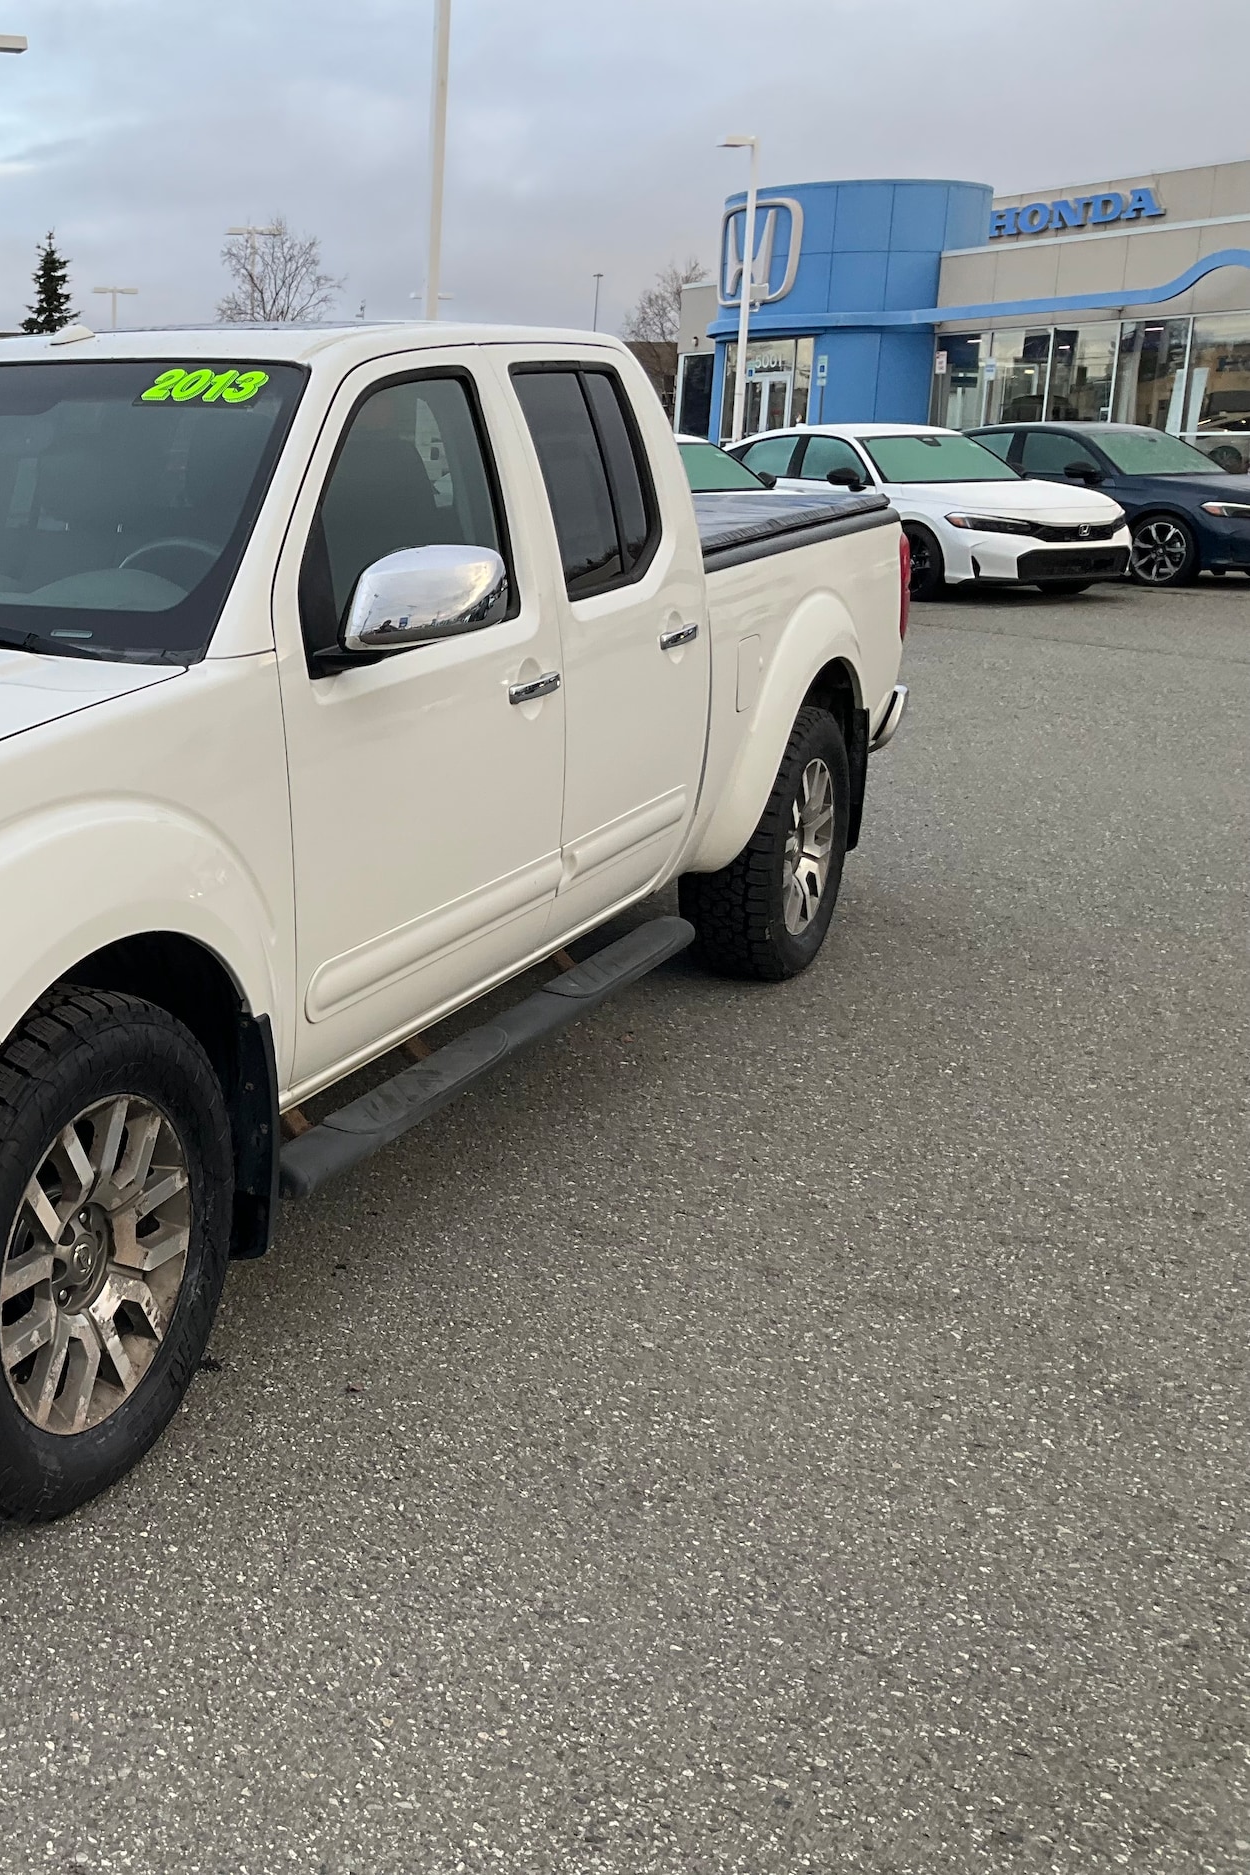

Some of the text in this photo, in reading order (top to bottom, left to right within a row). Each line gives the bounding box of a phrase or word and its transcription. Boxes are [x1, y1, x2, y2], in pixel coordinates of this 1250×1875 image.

[989, 187, 1165, 238] HONDA
[754, 353, 783, 369] 5001
[141, 368, 269, 403] 2013
